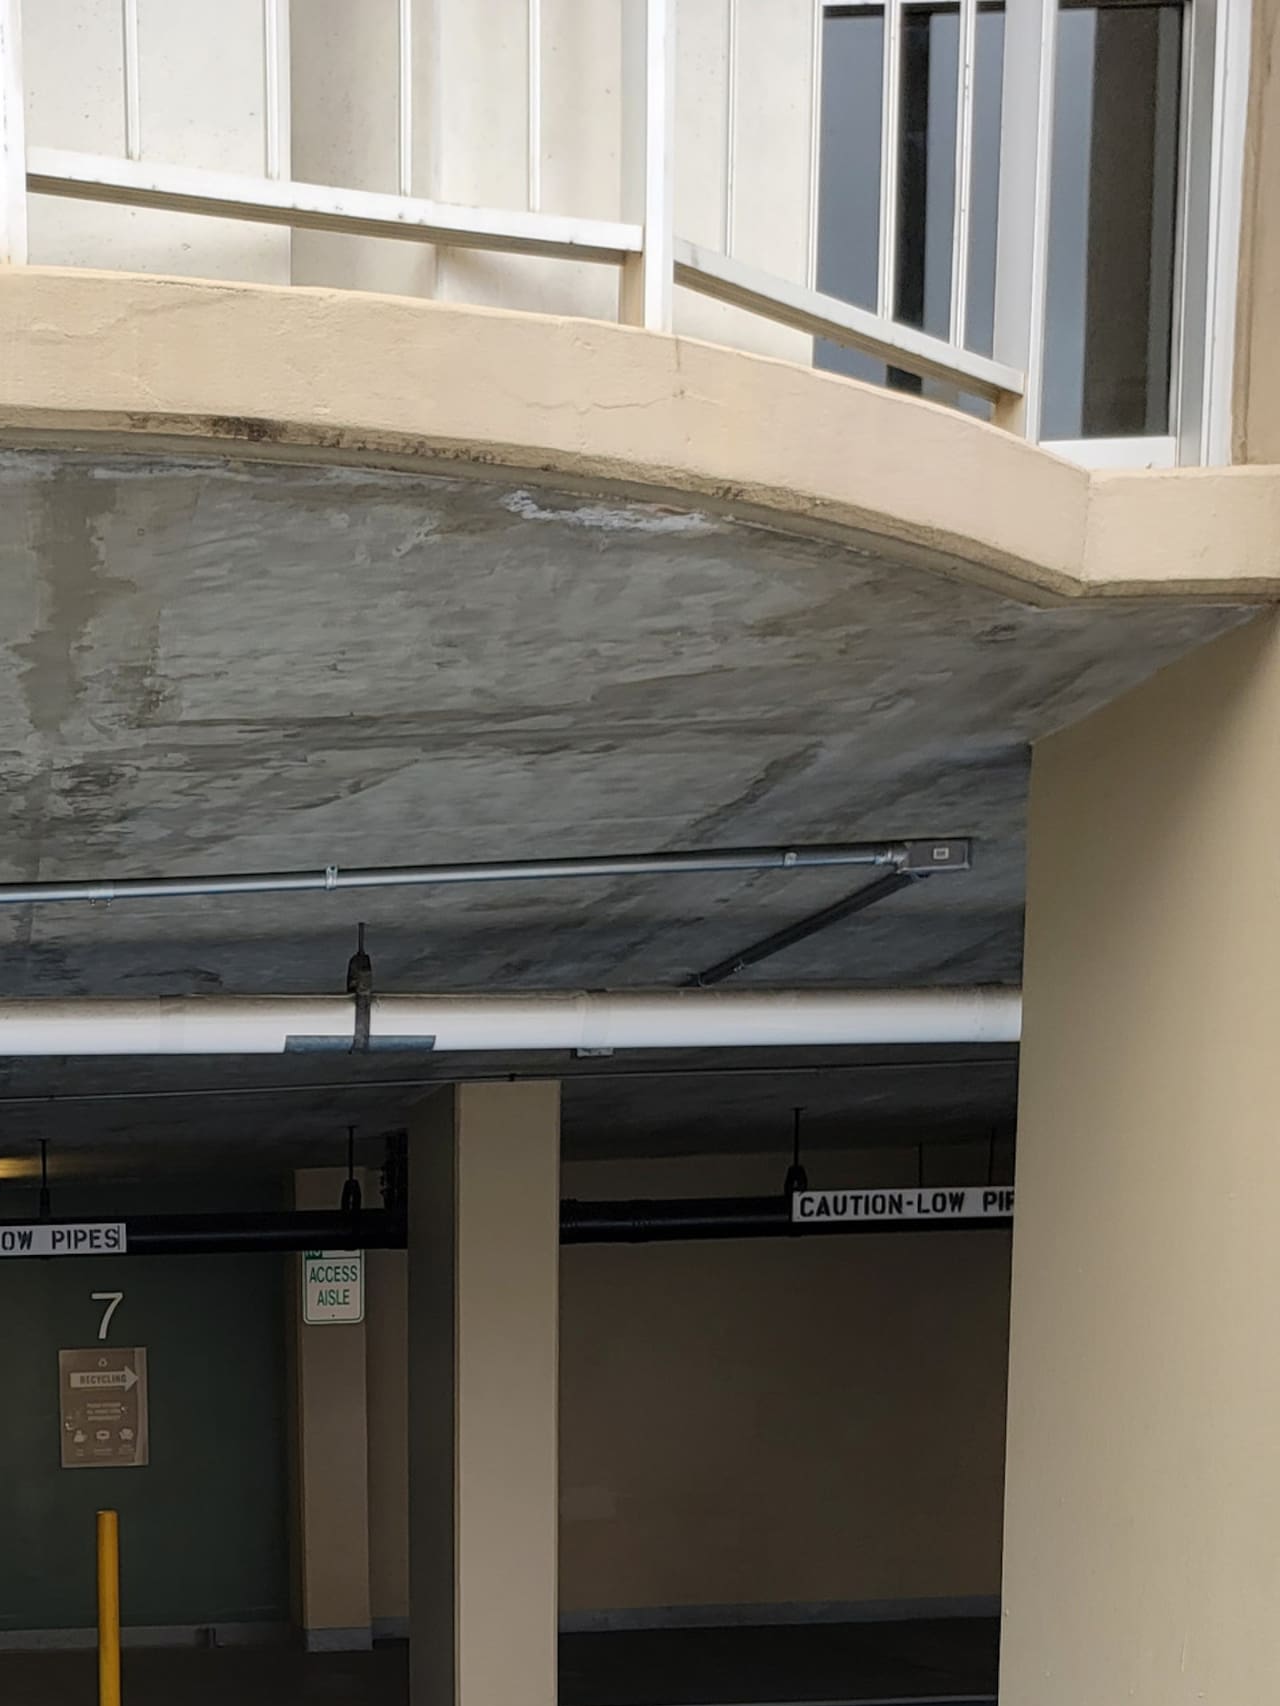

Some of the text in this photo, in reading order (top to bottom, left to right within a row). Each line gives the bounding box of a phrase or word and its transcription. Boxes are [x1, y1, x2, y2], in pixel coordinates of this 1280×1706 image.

[799, 1192, 965, 1217] CAUTION-LOW
[51, 1228, 119, 1250] PIPES
[309, 1265, 358, 1283] ACCESS
[317, 1288, 350, 1306] AISLE
[90, 1291, 124, 1340] 7
[79, 1374, 127, 1385] RECYCLING
